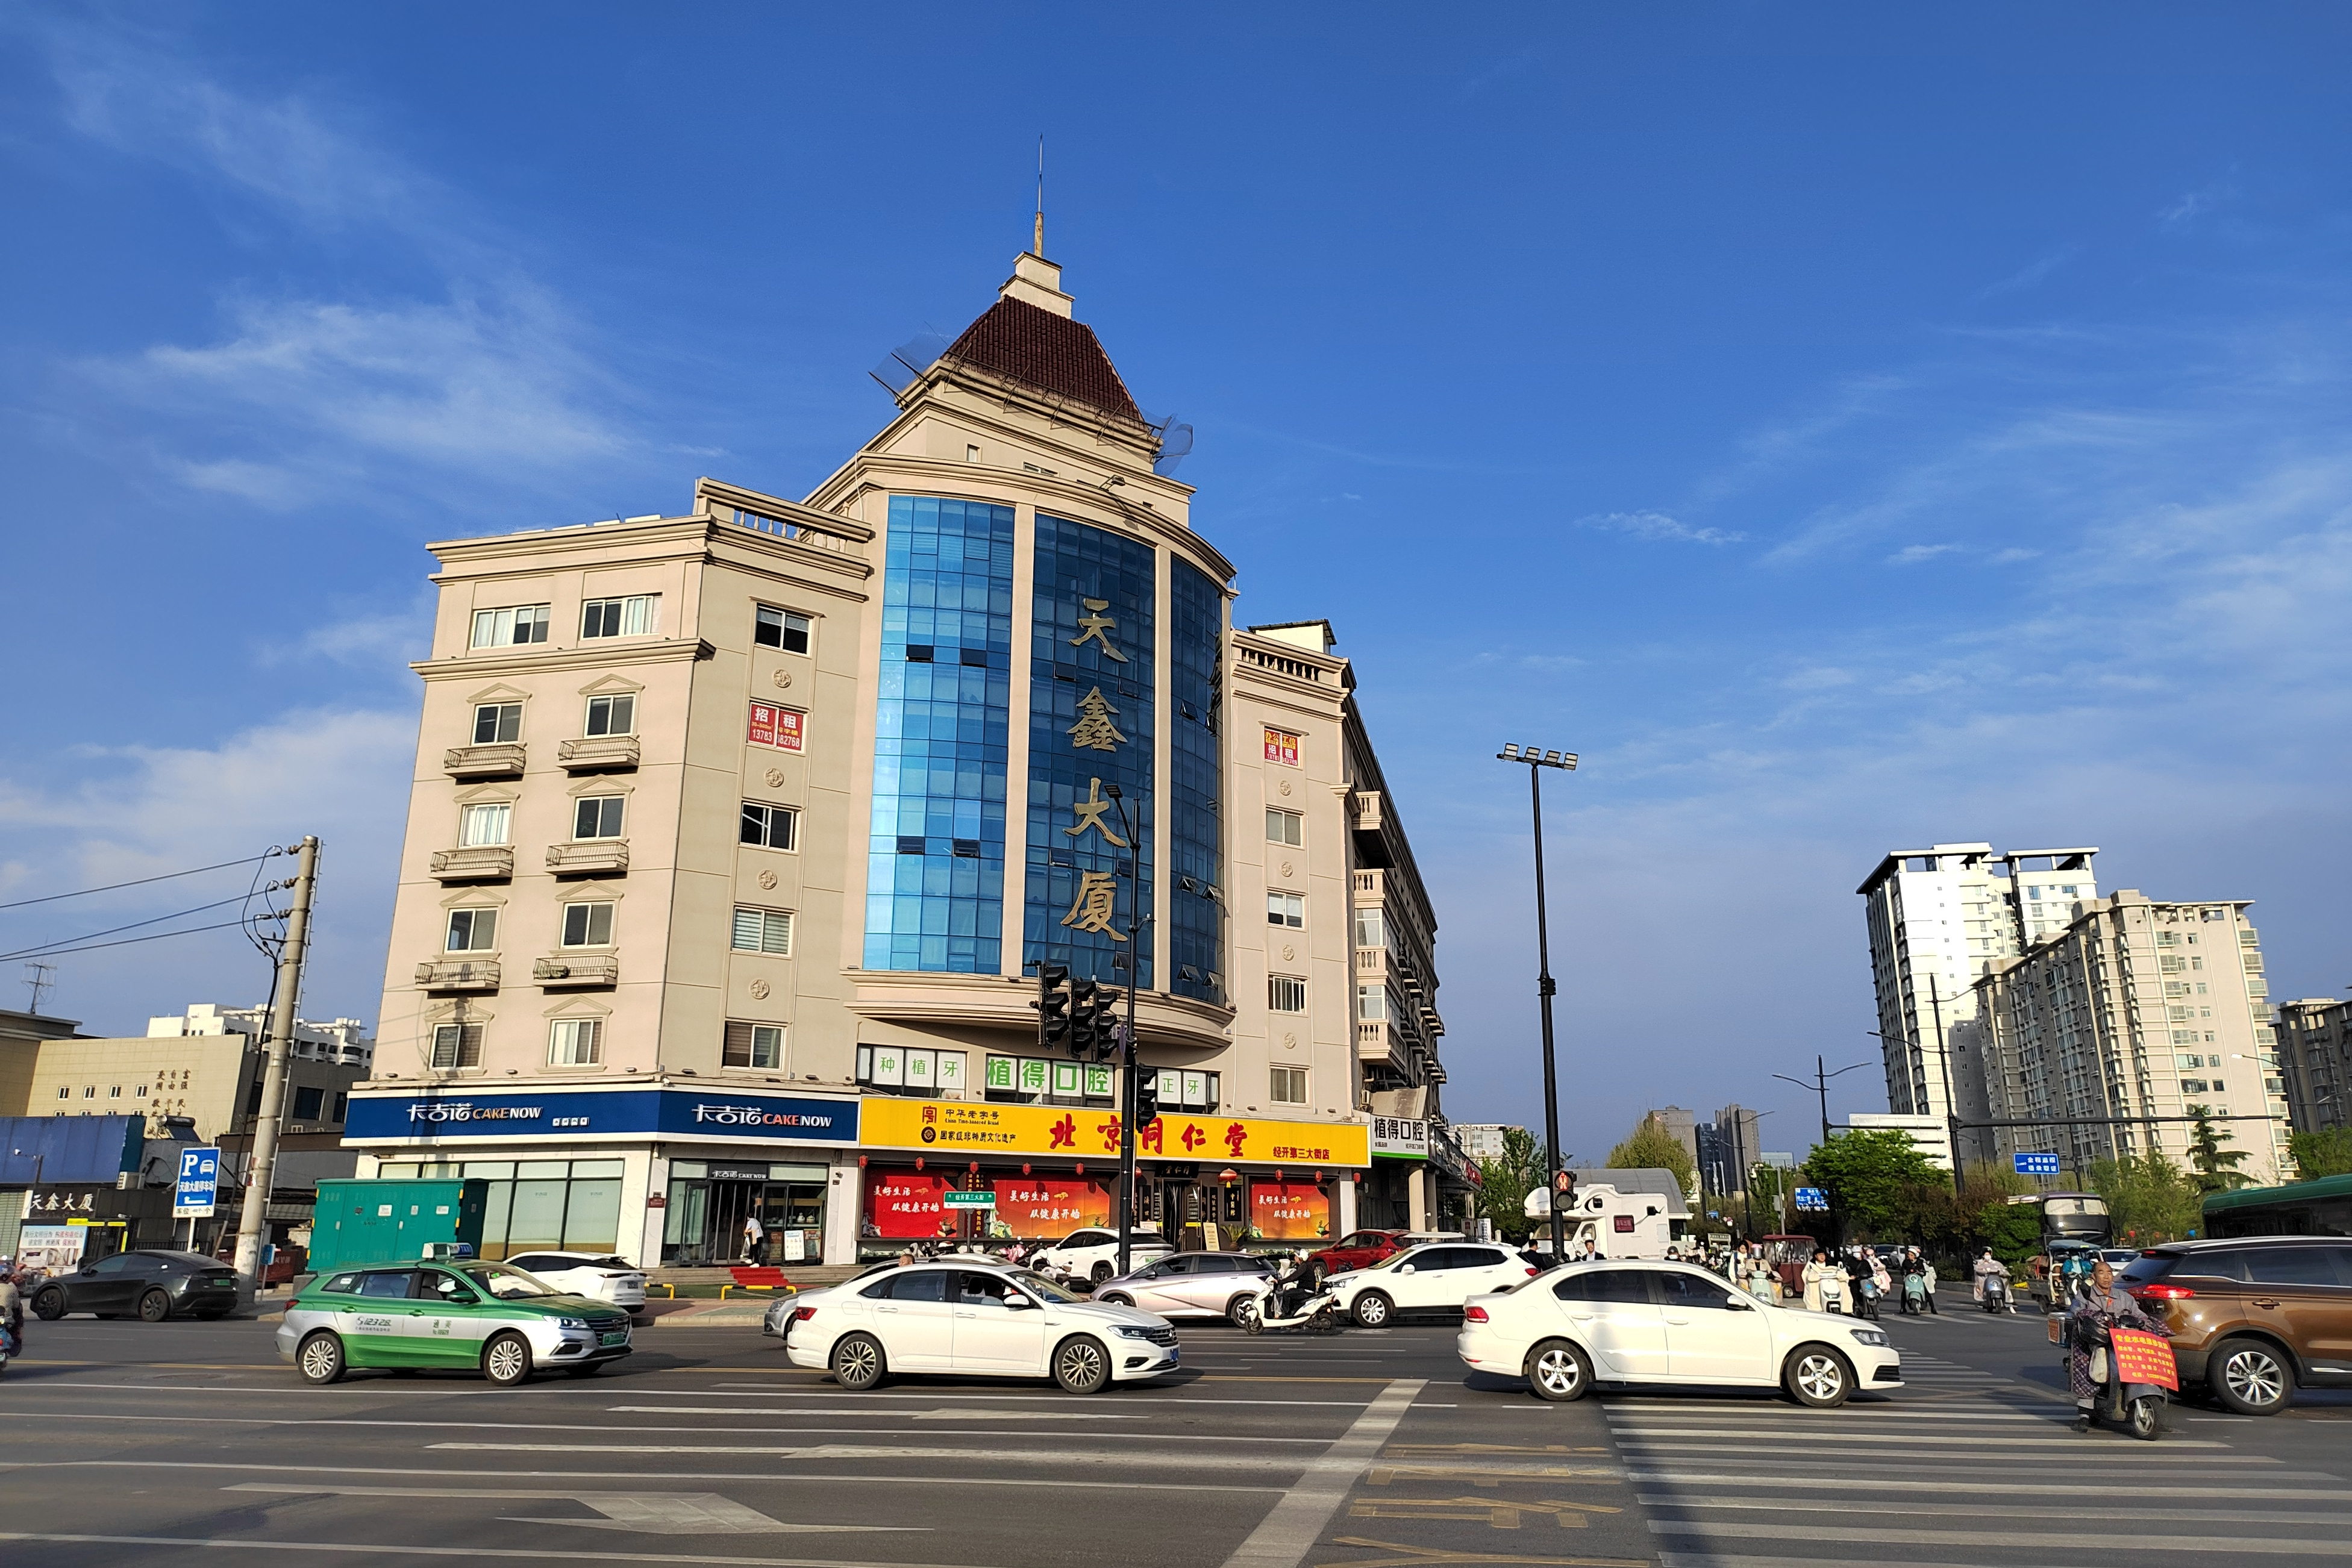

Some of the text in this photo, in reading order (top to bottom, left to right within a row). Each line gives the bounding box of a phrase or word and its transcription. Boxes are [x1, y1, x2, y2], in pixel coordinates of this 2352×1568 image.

[755, 707, 796, 729] 招租
[1060, 598, 1130, 943] 天鑫大厦
[880, 1056, 958, 1077] 种植牙
[987, 1058, 1109, 1093] 植得口腔
[1162, 1078, 1199, 1094] 正牙
[945, 1108, 999, 1120] 中华老字号
[1049, 1113, 1248, 1157] 北京同仁堂
[1374, 1117, 1424, 1142] 植得口腔
[1272, 1146, 1330, 1160] 经开第三大街店
[182, 1154, 199, 1176] P
[30, 1192, 94, 1212] 天鑫大厦
[1010, 1190, 1049, 1202] 美好生活
[891, 1201, 940, 1213] 从健康开始
[1030, 1207, 1080, 1220] 从健康开始
[1273, 1208, 1310, 1219] 从健康开始
